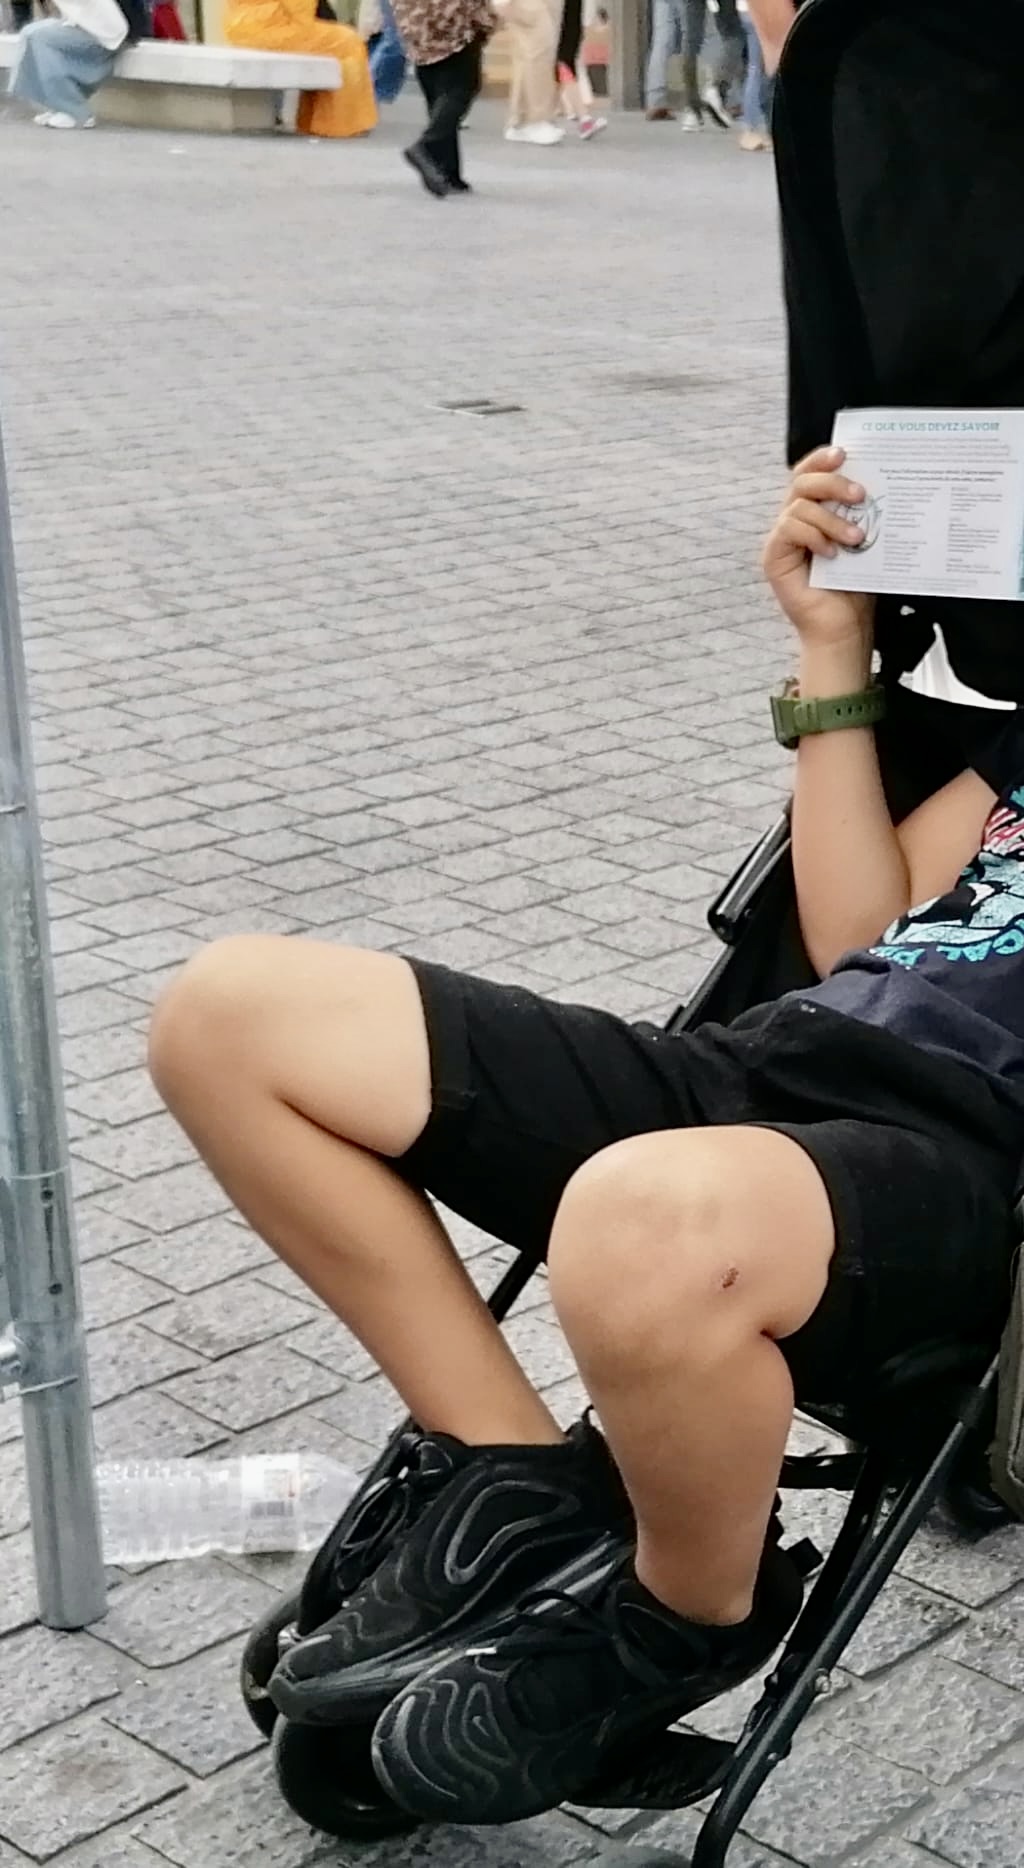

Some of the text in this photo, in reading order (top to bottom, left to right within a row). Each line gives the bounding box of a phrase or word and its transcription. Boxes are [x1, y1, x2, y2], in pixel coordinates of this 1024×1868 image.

[874, 422, 895, 431] QUE
[898, 422, 926, 431] VOUS
[928, 422, 960, 431] DEVEZ
[961, 422, 1000, 431] SAVOIR
